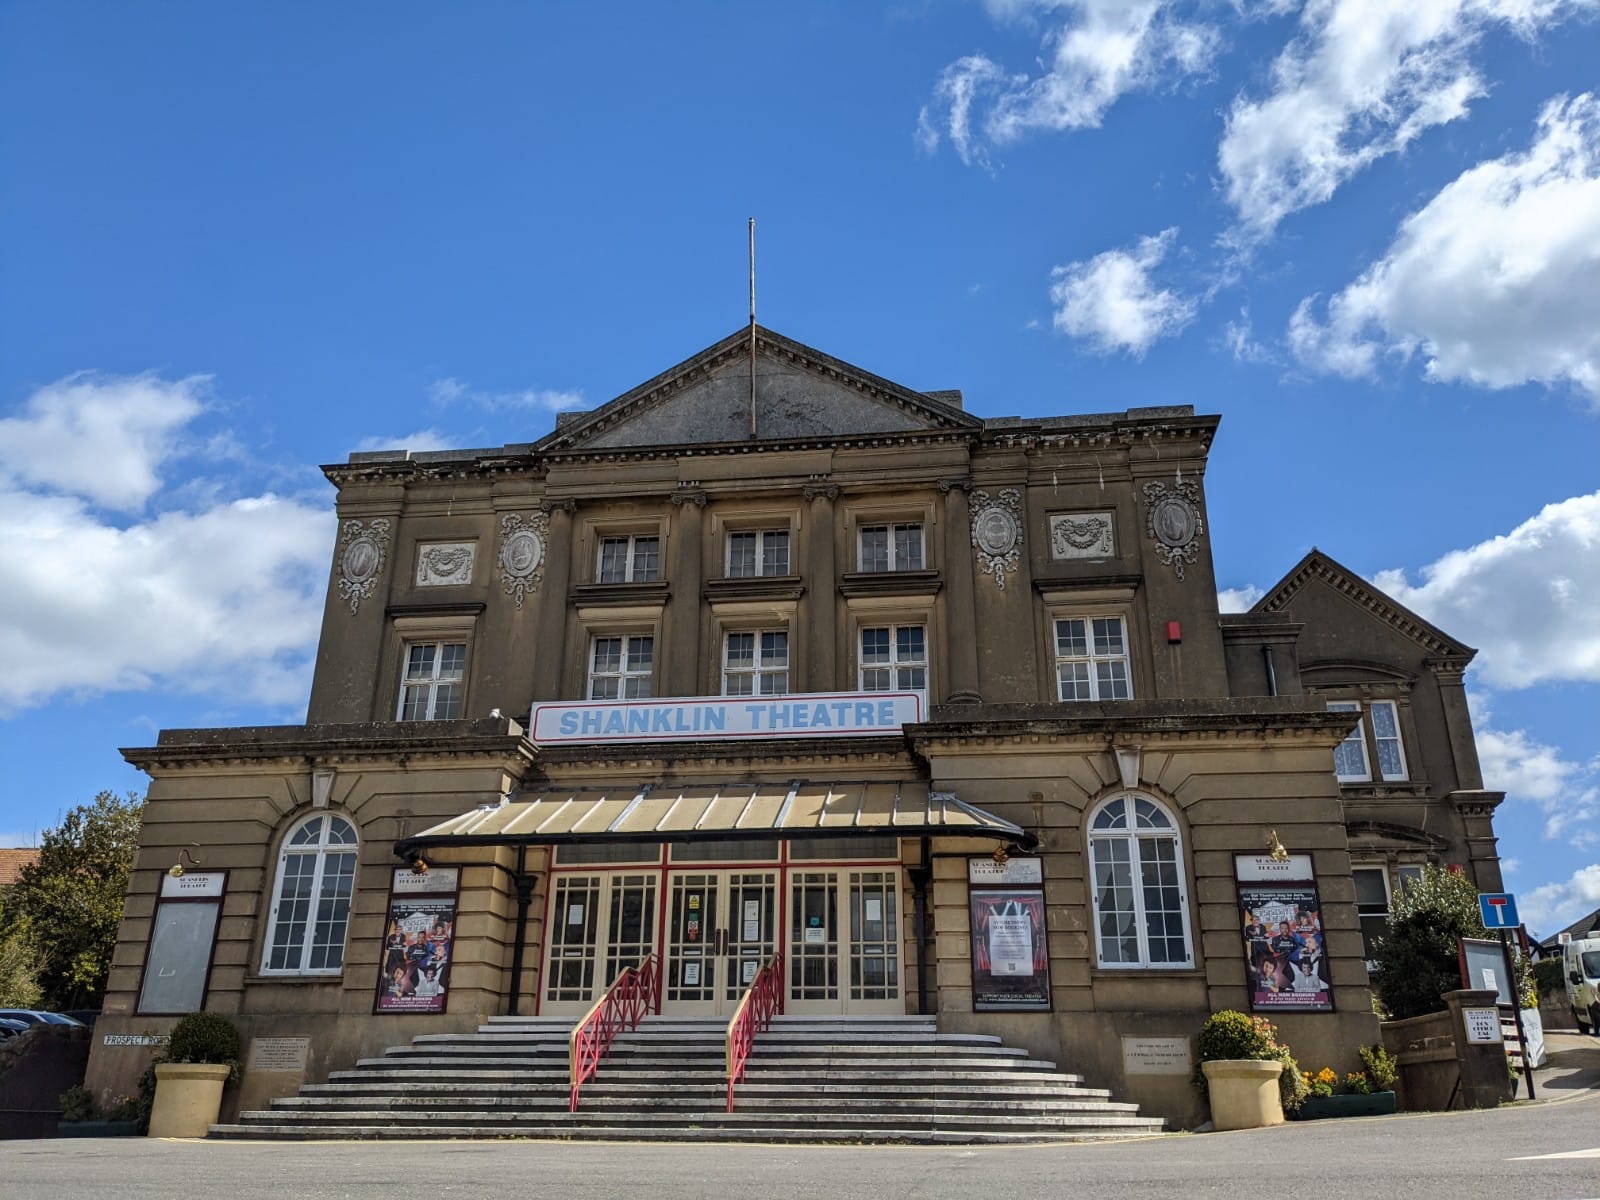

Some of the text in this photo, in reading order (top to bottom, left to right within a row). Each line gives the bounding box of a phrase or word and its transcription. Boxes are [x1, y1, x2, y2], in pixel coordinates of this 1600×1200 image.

[558, 700, 895, 735] SHANKLIN THEATRE
[106, 1036, 146, 1045] PROSPECT
